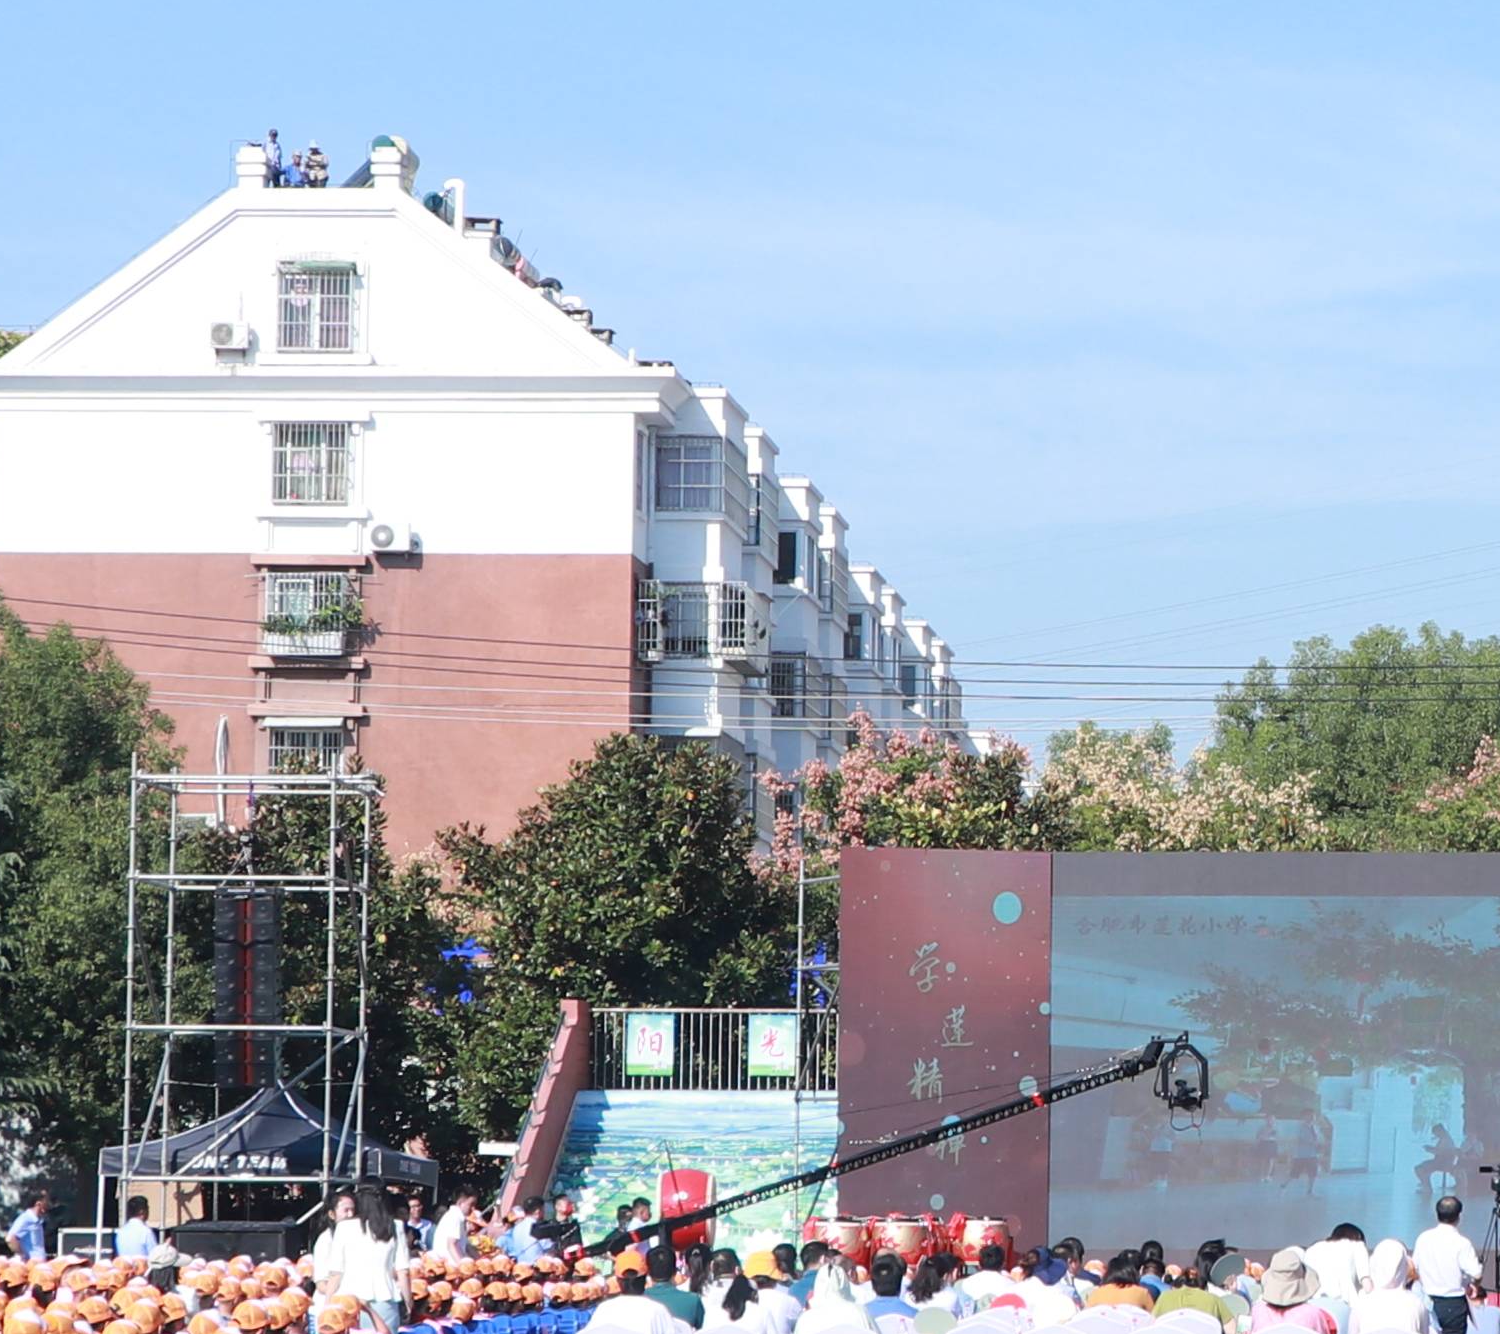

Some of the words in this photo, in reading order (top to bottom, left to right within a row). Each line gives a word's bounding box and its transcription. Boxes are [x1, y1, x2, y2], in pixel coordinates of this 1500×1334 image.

[637, 1026, 664, 1057] 阳
[759, 1027, 785, 1058] 光
[236, 1154, 288, 1169] TEAM
